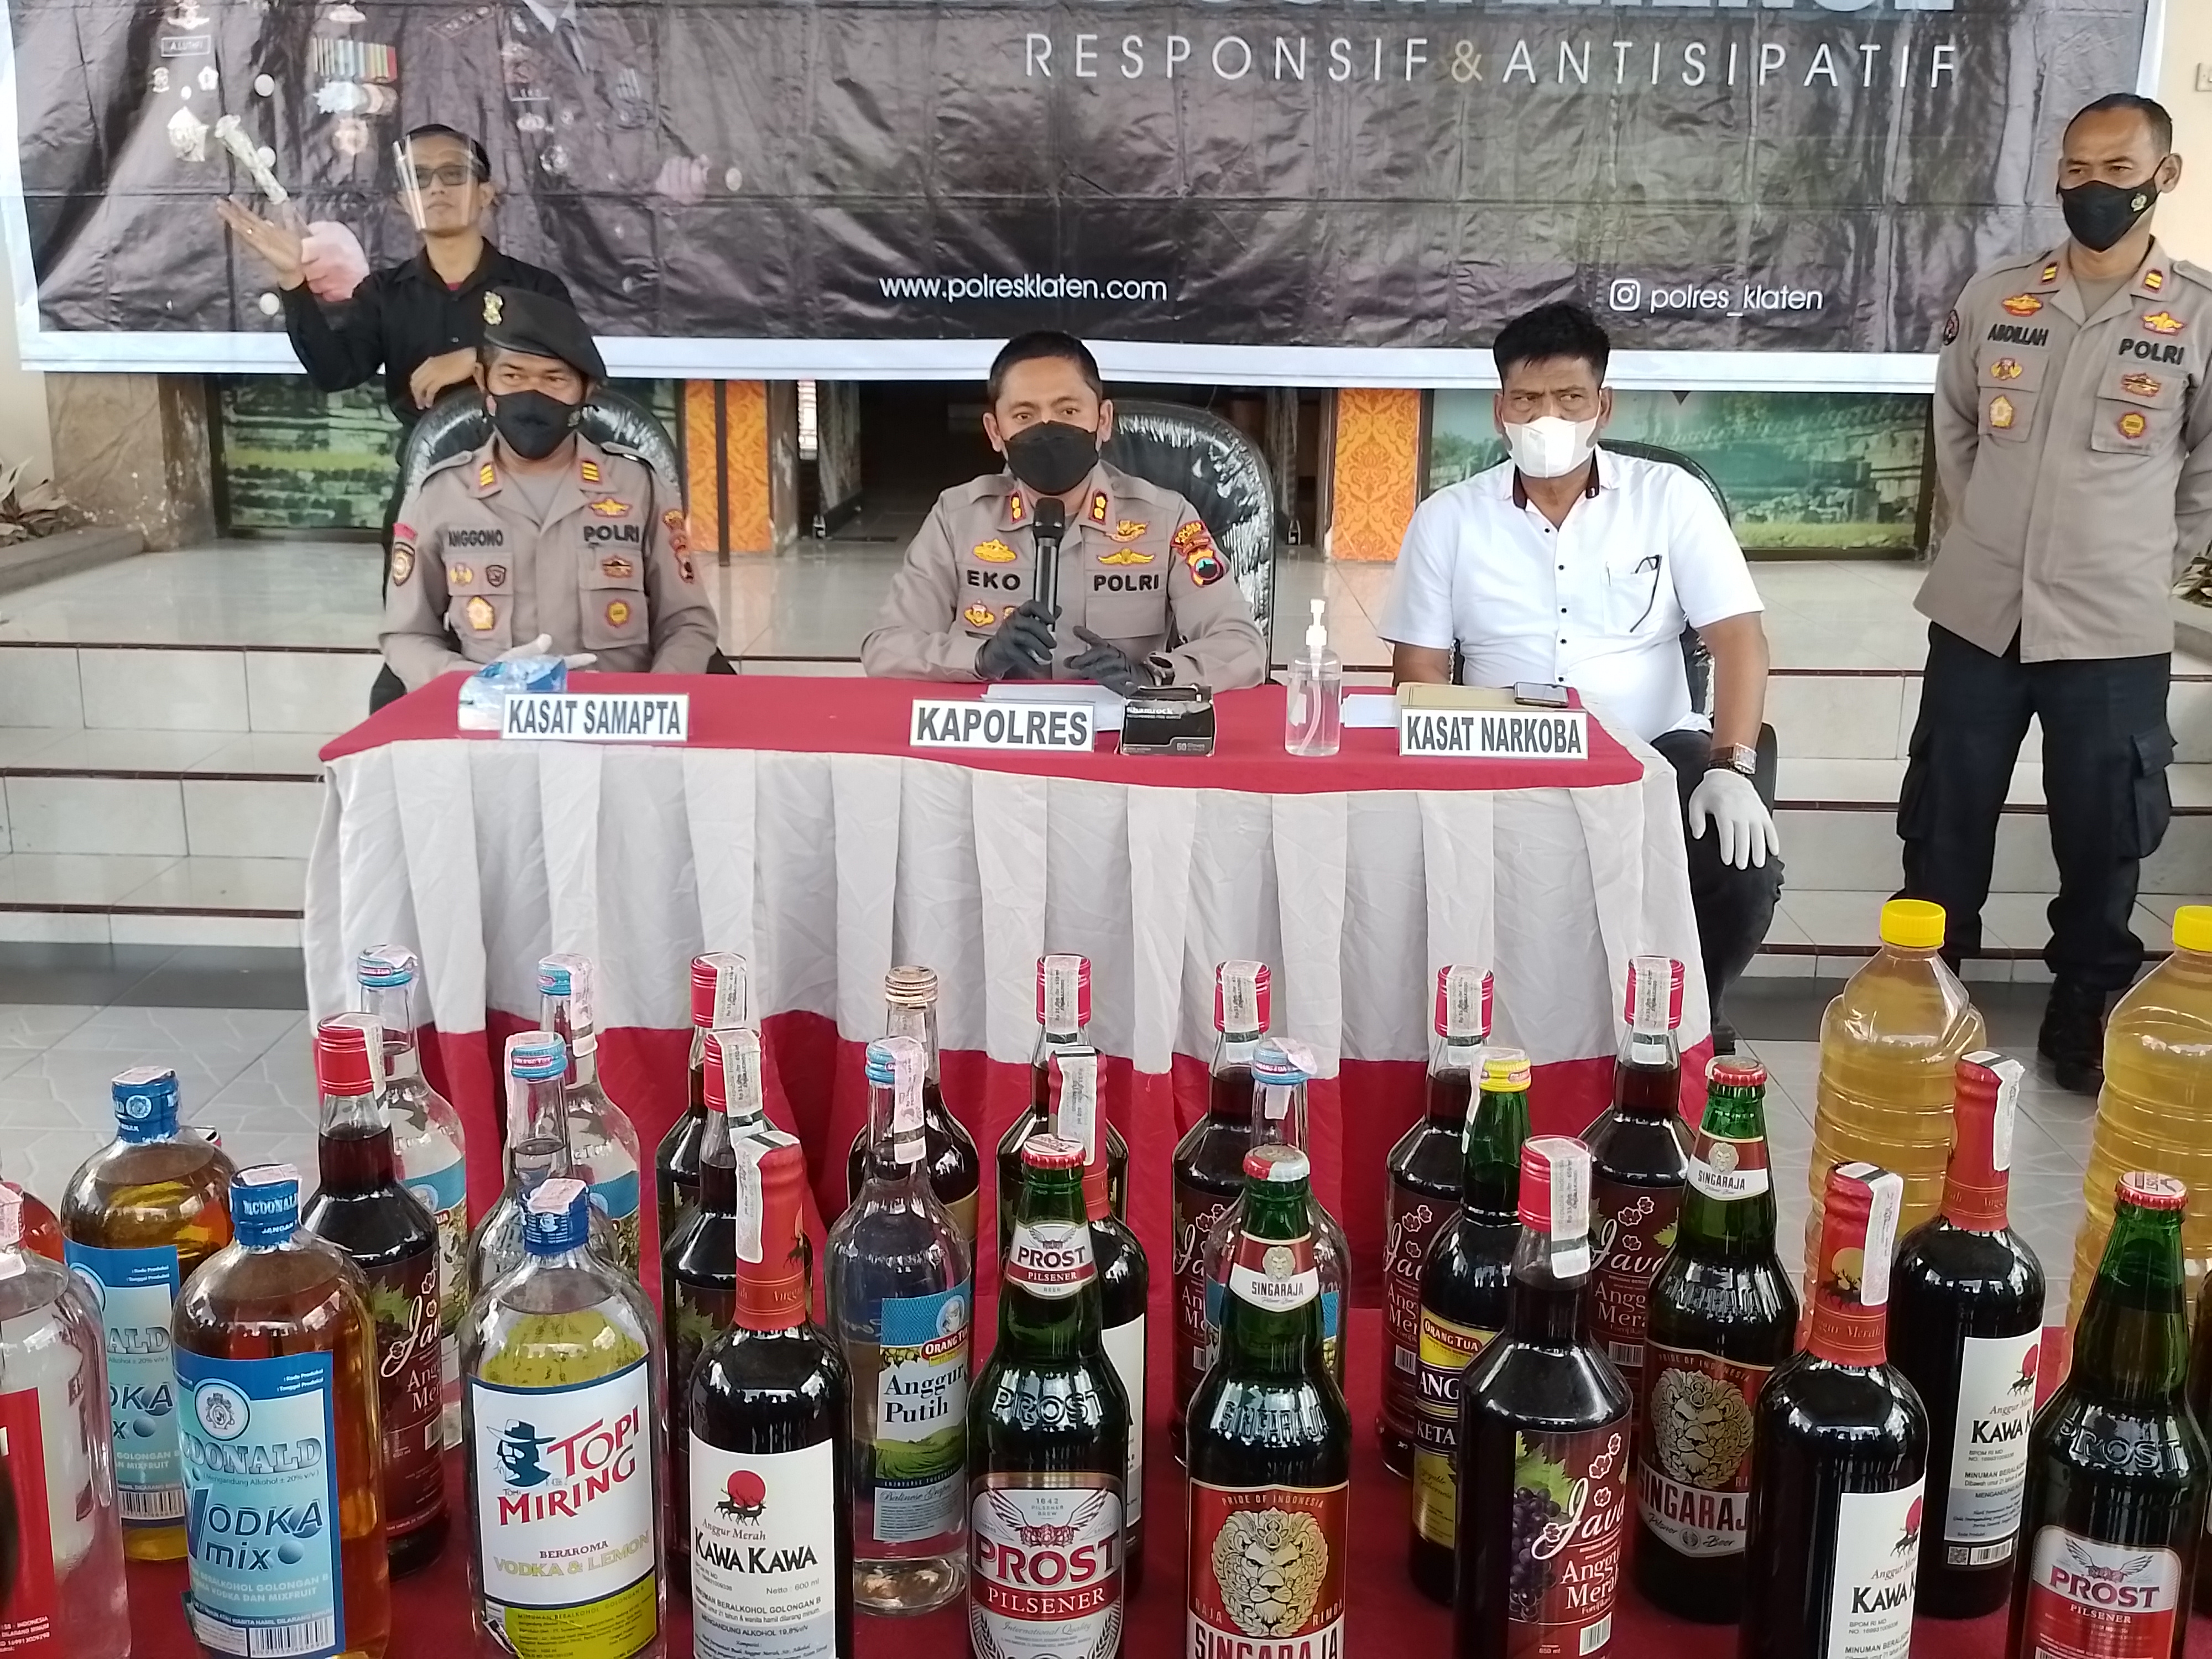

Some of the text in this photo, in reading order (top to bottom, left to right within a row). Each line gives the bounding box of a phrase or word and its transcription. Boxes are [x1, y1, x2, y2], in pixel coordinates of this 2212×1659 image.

[1025, 33, 1955, 88] RESPONSIF & ANTISIPATIF
[879, 273, 1168, 303] www.polresklaten.com
[1650, 283, 1823, 317] polres_klaten
[1987, 323, 2049, 347] ABDILLAH
[2118, 338, 2185, 366] POLRI
[583, 525, 640, 543] POLRI
[967, 569, 1021, 591] EKO
[1094, 573, 1159, 592] POLRI
[508, 700, 681, 735] KASAT SAMAPTA
[917, 707, 1088, 746] KAPOLRES
[1407, 716, 1582, 754] KASAT NARKOBA
[1698, 1170, 1746, 1191] SINGARAJA
[262, 1222, 294, 1234] JANGAN
[1017, 1245, 1086, 1268] PROST
[1027, 1271, 1078, 1282] PILSENER
[1251, 1281, 1304, 1297] SINGARAJA
[925, 1336, 957, 1354] ORANG
[1425, 1320, 1454, 1344] ORANG
[1454, 1335, 1479, 1352] TUA
[1684, 1357, 1695, 1365] OF
[884, 1364, 964, 1399] Anggur
[884, 1396, 949, 1423] Putih
[1989, 1403, 2018, 1416] Anggur
[546, 1404, 639, 1478] TOPI
[1971, 1418, 2023, 1444] KAWA
[497, 1443, 635, 1526] MIRING
[1221, 1494, 1325, 1509] PRIDE OF INDONESIA
[702, 1518, 766, 1541] Anggur Merah
[540, 1540, 609, 1559] BERAROMA
[695, 1526, 818, 1574] KAWA KAWA
[1702, 1535, 1736, 1548] Beer
[205, 1541, 272, 1571] mix
[493, 1530, 650, 1577] VODKA & LEMON
[974, 1529, 1120, 1587] PROST
[794, 1581, 809, 1591] 600
[811, 1578, 820, 1587] ml
[1870, 1565, 1903, 1581] Anggur
[1851, 1581, 1908, 1614] KAWA
[2049, 1564, 2160, 1609] PROST
[717, 1599, 768, 1614] BERALKOHOL
[769, 1601, 814, 1614] GOLONGAN
[816, 1596, 821, 1604] B
[988, 1587, 1105, 1614] PILSENER
[2070, 1604, 2132, 1625] PILSENER
[1000, 1621, 1092, 1636] International Quality
[1845, 1644, 1881, 1654] MINUMAN
